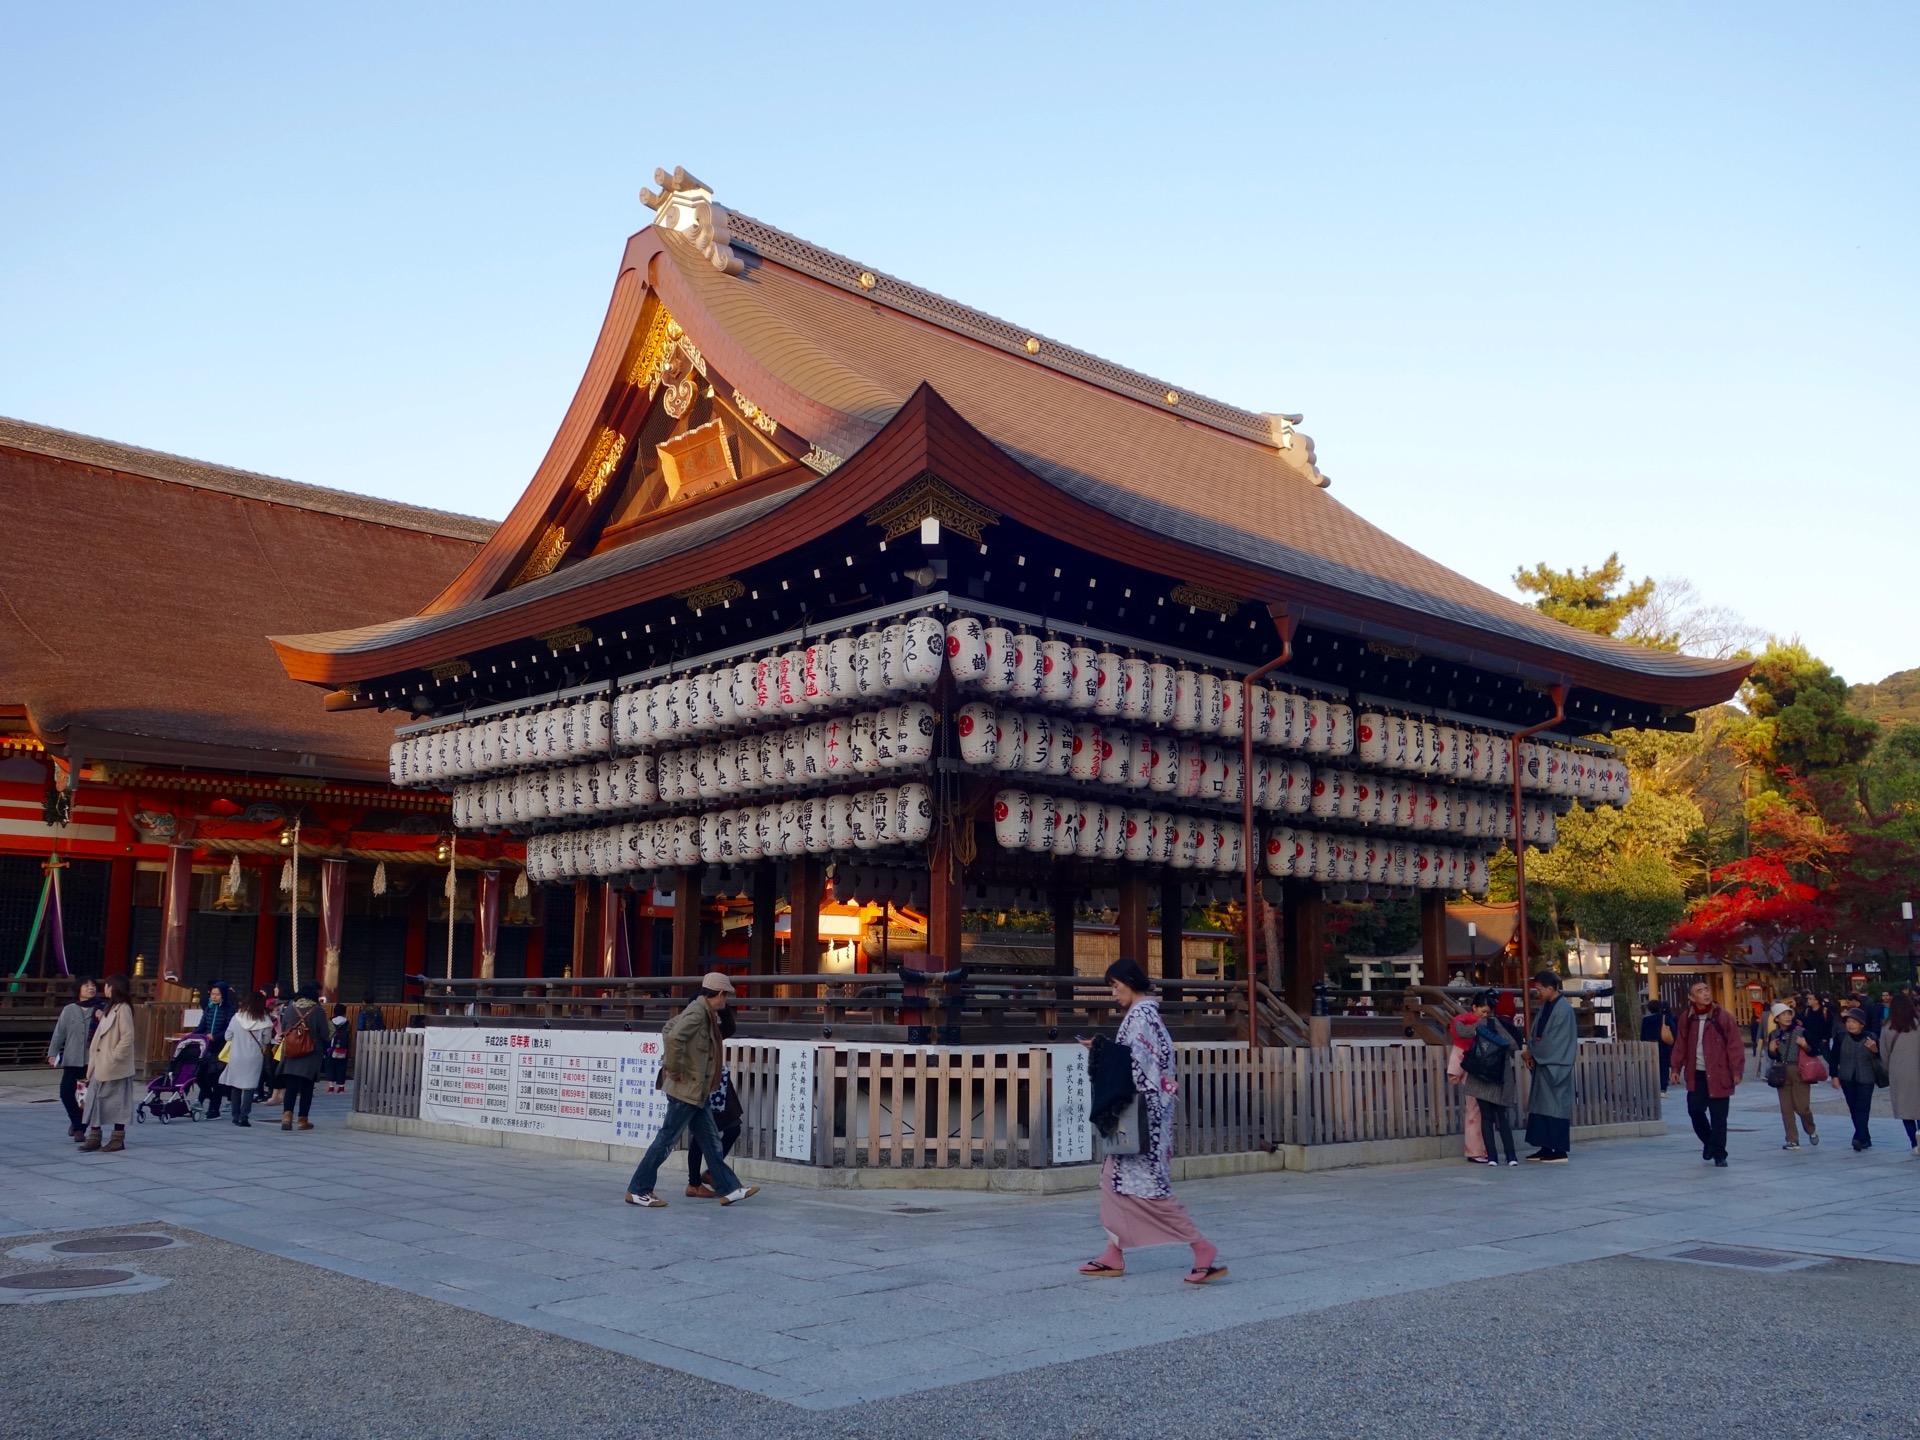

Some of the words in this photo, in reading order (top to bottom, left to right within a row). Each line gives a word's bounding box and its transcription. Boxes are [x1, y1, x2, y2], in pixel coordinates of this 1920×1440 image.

[967, 622, 987, 671] 孝鶴
[1002, 632, 1015, 685] 鳥居本
[1085, 654, 1098, 697] 辻留
[690, 678, 700, 725] まつもと
[761, 734, 773, 780] 久富美
[803, 727, 817, 773] 小扇
[877, 727, 893, 759] 天塩
[898, 730, 910, 754] 和田
[1033, 717, 1049, 764] キメラ
[1138, 739, 1150, 778] 豆花
[1166, 740, 1178, 785] 美の八重
[1212, 750, 1225, 791] 川口
[851, 799, 867, 841] 大晃
[876, 792, 890, 841] 西川菊人
[1018, 793, 1030, 844] 元奈古
[1042, 798, 1055, 848] 元奈古
[471, 1053, 481, 1062] 本厄
[485, 1036, 508, 1047] 平成28年
[510, 1034, 530, 1048] 厄年表
[522, 1056, 533, 1065] 女性
[569, 1058, 581, 1068] 本厄
[562, 1072, 586, 1083] 平成10年生
[519, 1101, 531, 1111] 37歳
[788, 1061, 797, 1154] 挙式をお受けします
[798, 1050, 807, 1154] 本殿・舞殿・儀式殿にて
[1066, 1063, 1074, 1157] 挙式をお受けします
[1076, 1051, 1085, 1154] 本殿・舞殿・儀式殿にて
